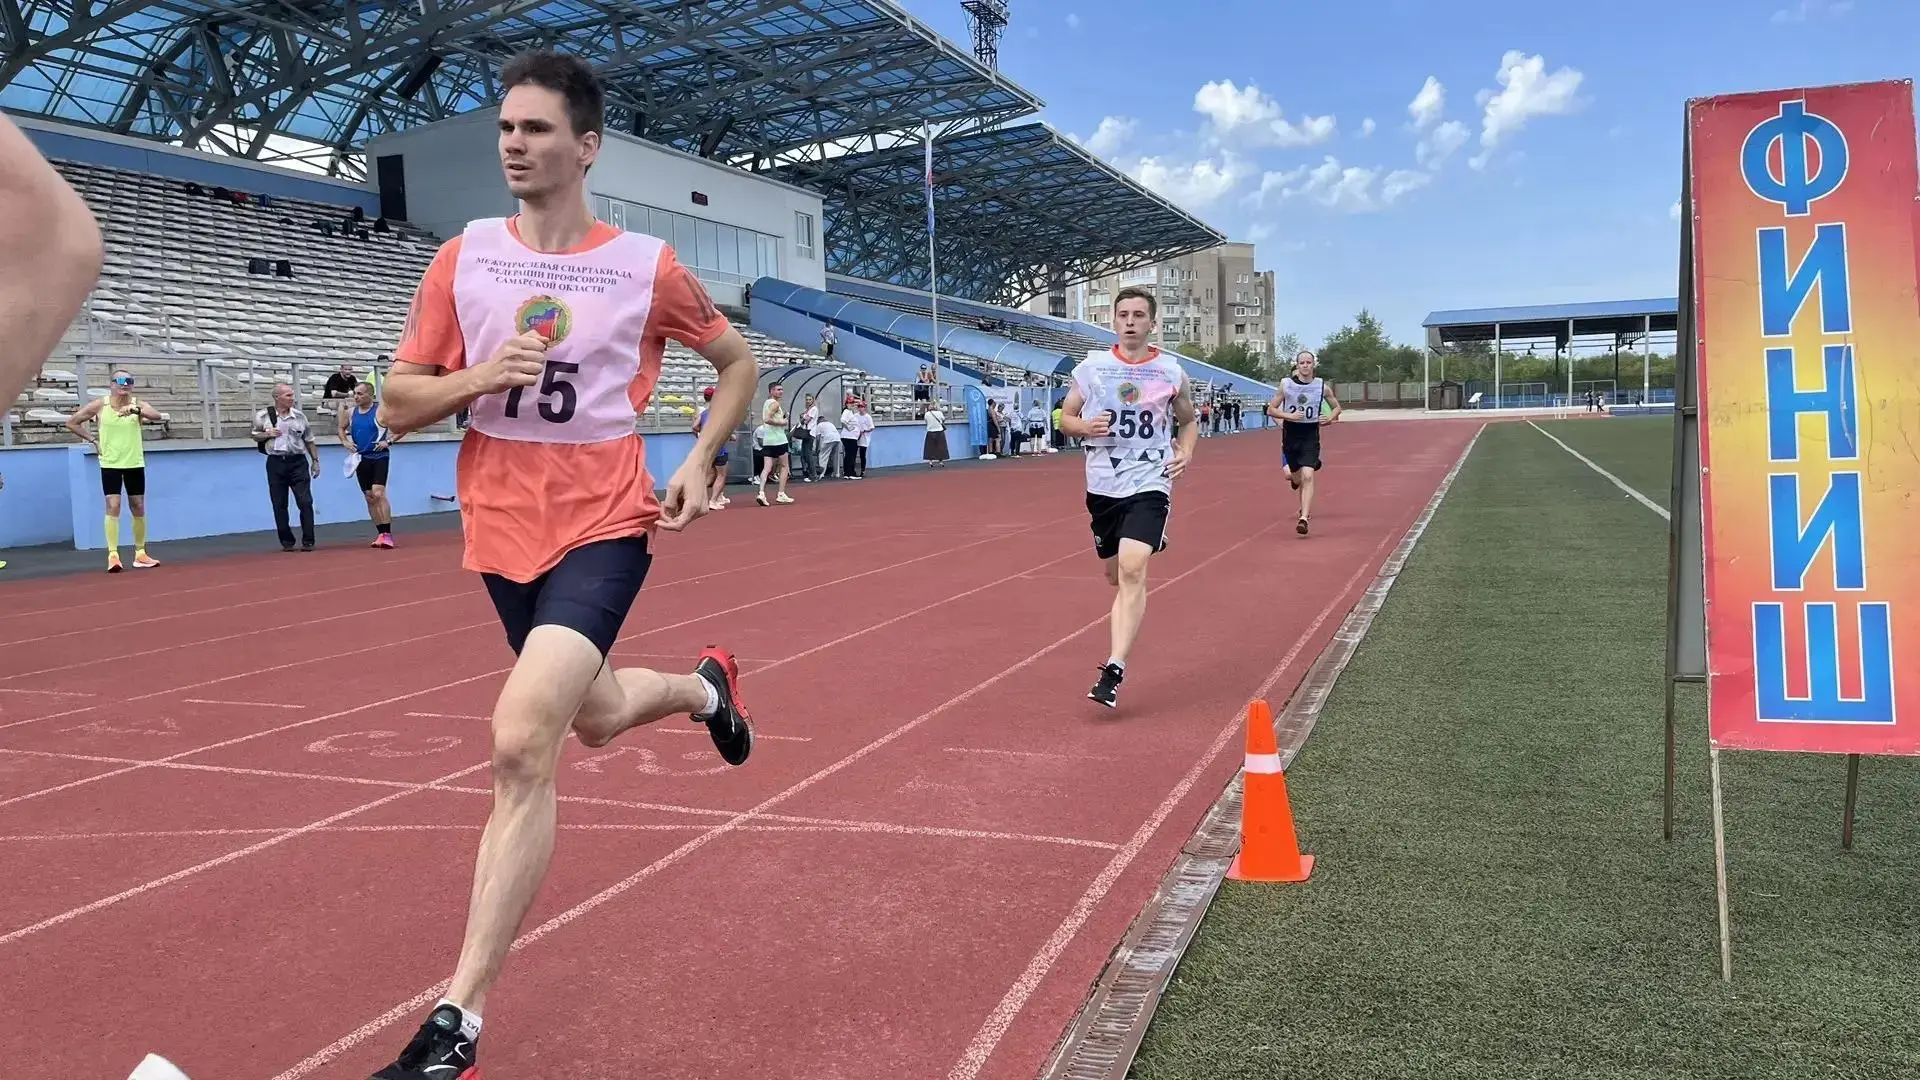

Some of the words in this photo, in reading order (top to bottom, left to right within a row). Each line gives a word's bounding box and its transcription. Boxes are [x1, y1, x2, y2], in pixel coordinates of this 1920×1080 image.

[487, 267, 545, 279] ФЕДЕРАЦИИ
[547, 272, 617, 285] ПРОФСОЮЗОВ
[561, 264, 633, 279] СПАРТАКИАДА
[558, 283, 605, 293] ОБЛАСТИ
[1740, 100, 1896, 724] ФИНИШ
[1104, 409, 1154, 439] 258
